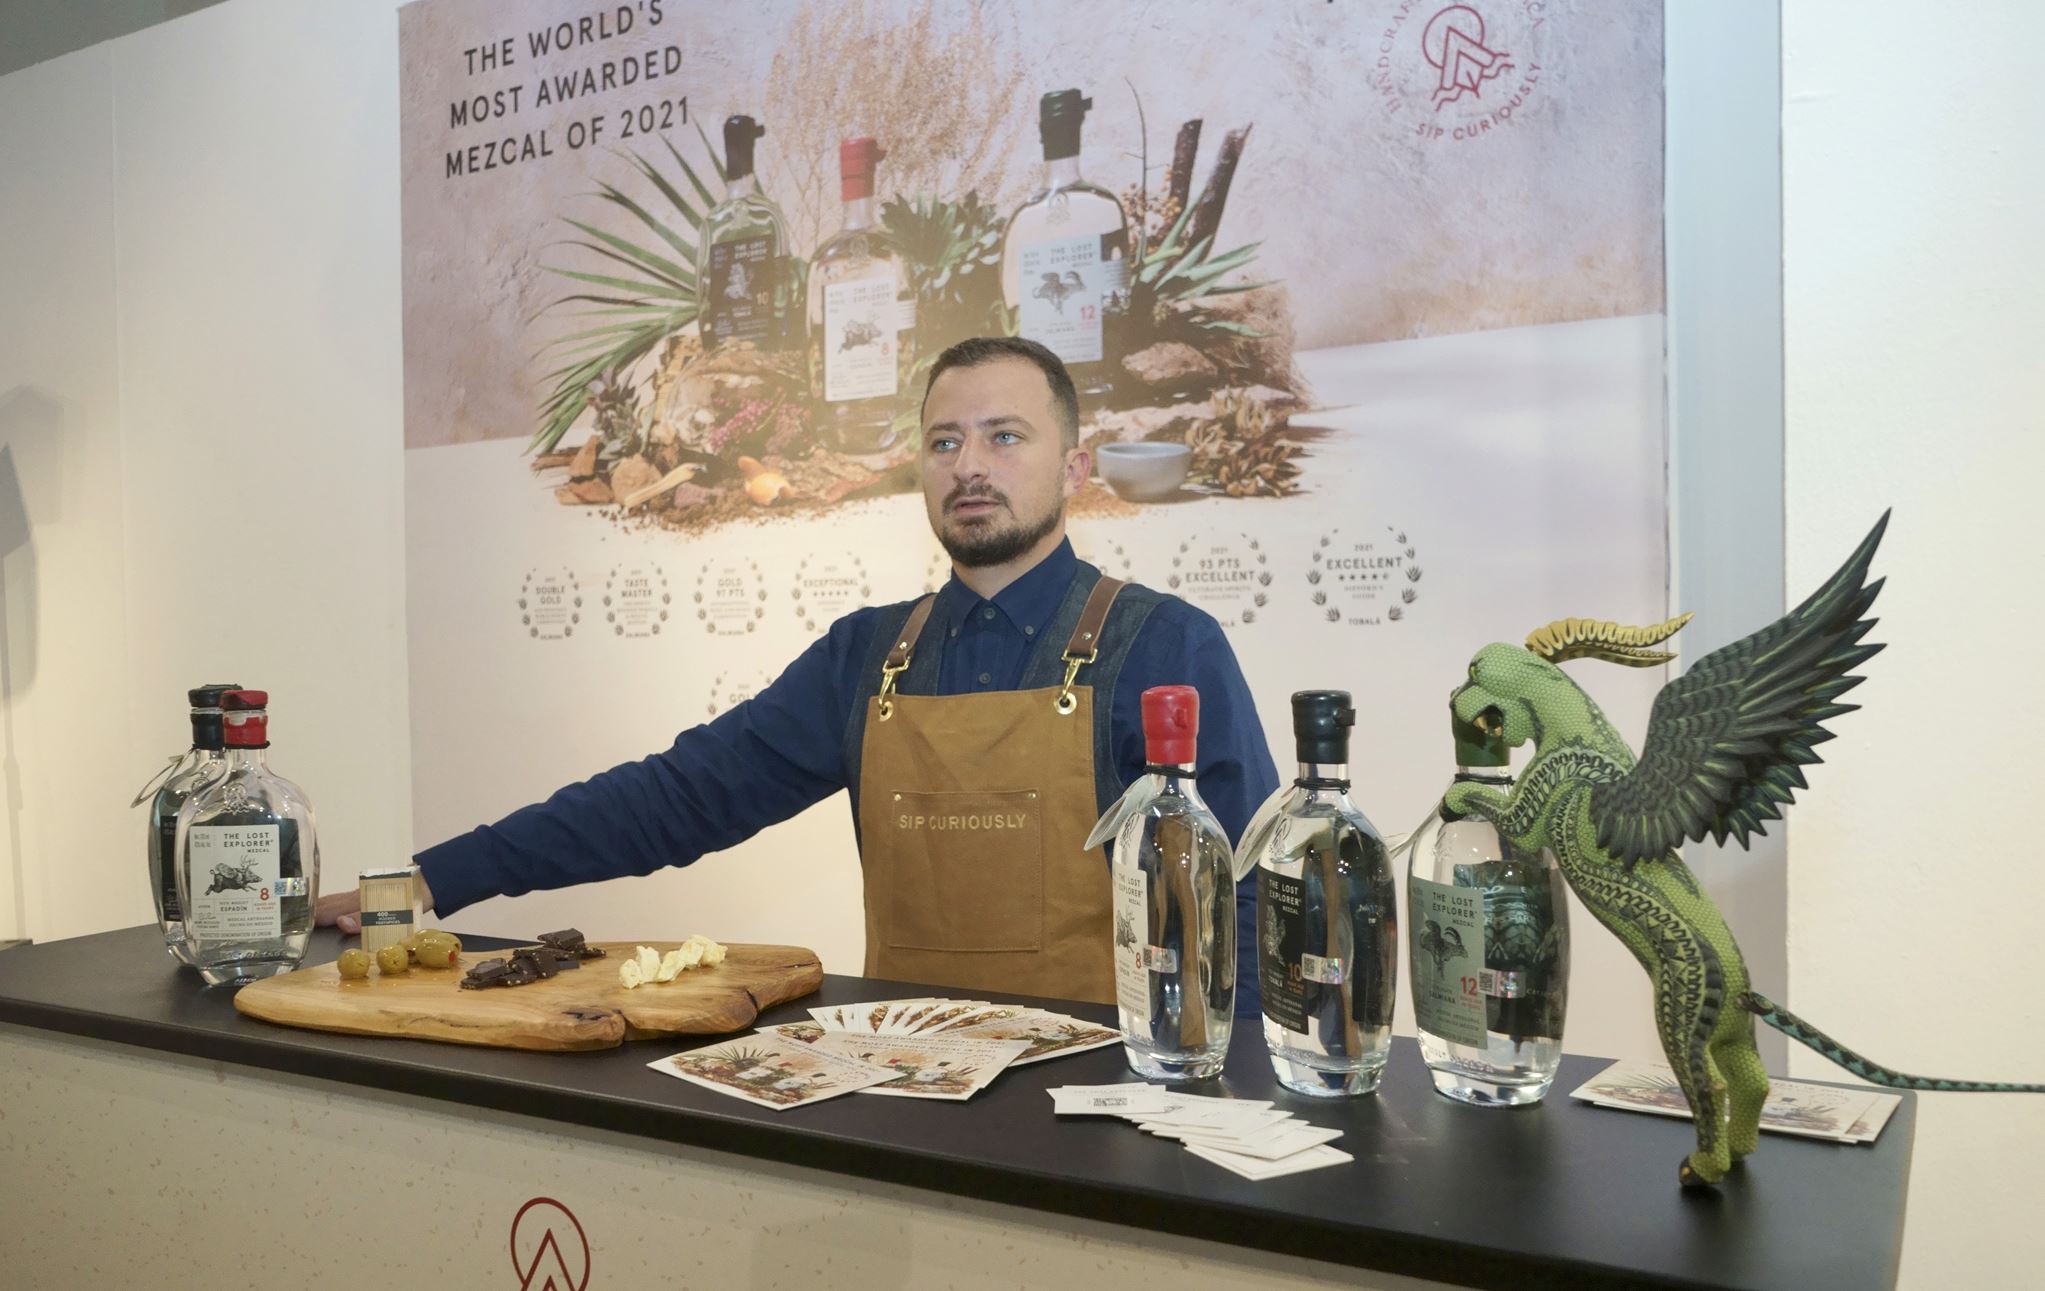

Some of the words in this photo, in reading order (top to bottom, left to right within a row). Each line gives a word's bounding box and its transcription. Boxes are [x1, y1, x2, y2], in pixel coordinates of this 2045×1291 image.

[464, 37, 515, 76] THE
[528, 0, 664, 59] WORLD'S
[449, 86, 523, 129] MOST
[535, 45, 682, 108] AWARDED
[1415, 122, 1445, 140] SIP
[1452, 62, 1541, 141] CURIOUSLY
[445, 130, 553, 179] MEZCAL
[566, 116, 605, 149] OF
[620, 95, 690, 139] 2021
[756, 291, 769, 305] 10
[1080, 304, 1096, 321] 12
[1218, 558, 1240, 569] PTS
[1326, 555, 1402, 570] EXCELLENT
[717, 577, 743, 587] GOLD
[1185, 570, 1254, 582] EXCELLENT
[535, 585, 566, 595] DOUBLE
[625, 579, 649, 588] TASTE
[803, 579, 858, 588] EXCEPTIONAL
[621, 589, 653, 598] MASTER
[729, 588, 745, 597] PTS
[540, 595, 562, 605] GOLD
[899, 814, 924, 829] SIP
[928, 813, 1026, 830] CURIOUSLY
[224, 832, 240, 840] THE
[1127, 876, 1141, 887] LOST
[1268, 879, 1279, 890] THE
[1281, 883, 1299, 895] LOST
[260, 888, 269, 901] 8
[1432, 891, 1446, 903] THE
[1451, 896, 1473, 908] LOST
[1135, 952, 1142, 969] 8
[1288, 963, 1302, 982] 10
[1460, 975, 1478, 997] 12
